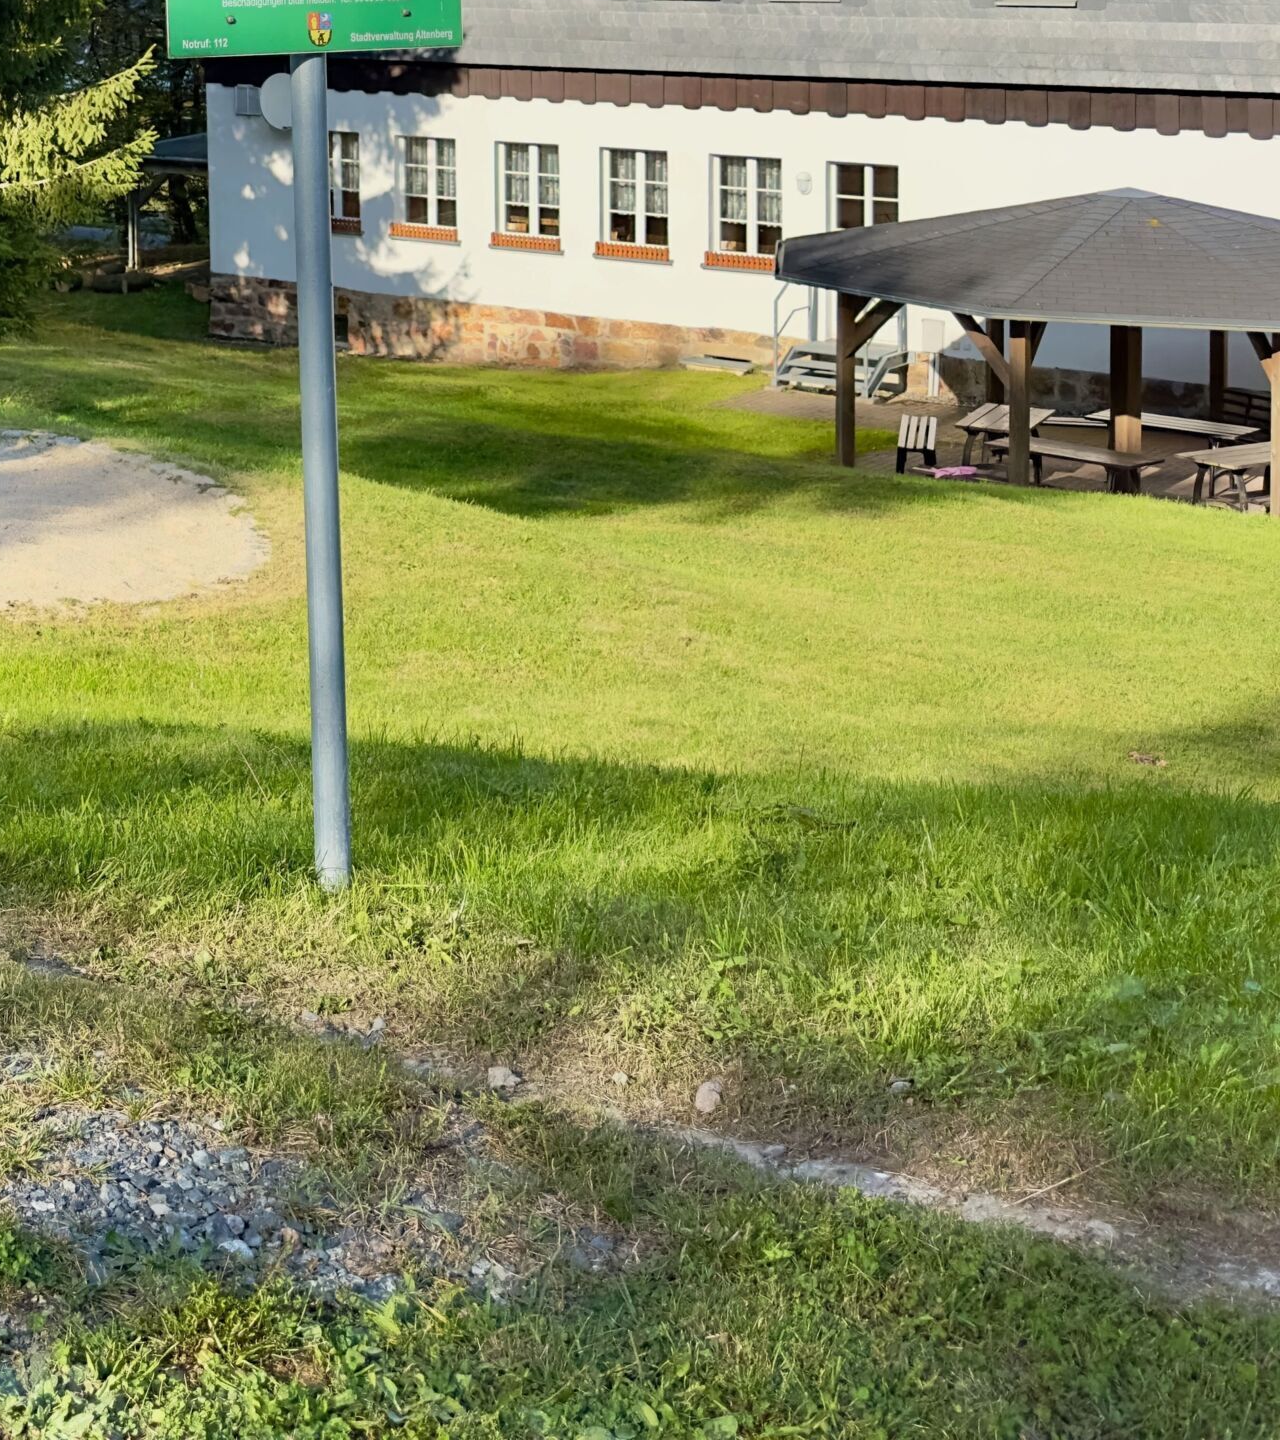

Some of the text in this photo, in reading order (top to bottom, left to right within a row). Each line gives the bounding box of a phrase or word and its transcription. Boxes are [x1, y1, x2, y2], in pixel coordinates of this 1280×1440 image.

[350, 29, 453, 42] Stadtverwaltung Altenberg
[182, 38, 228, 49] Notruf: 112
